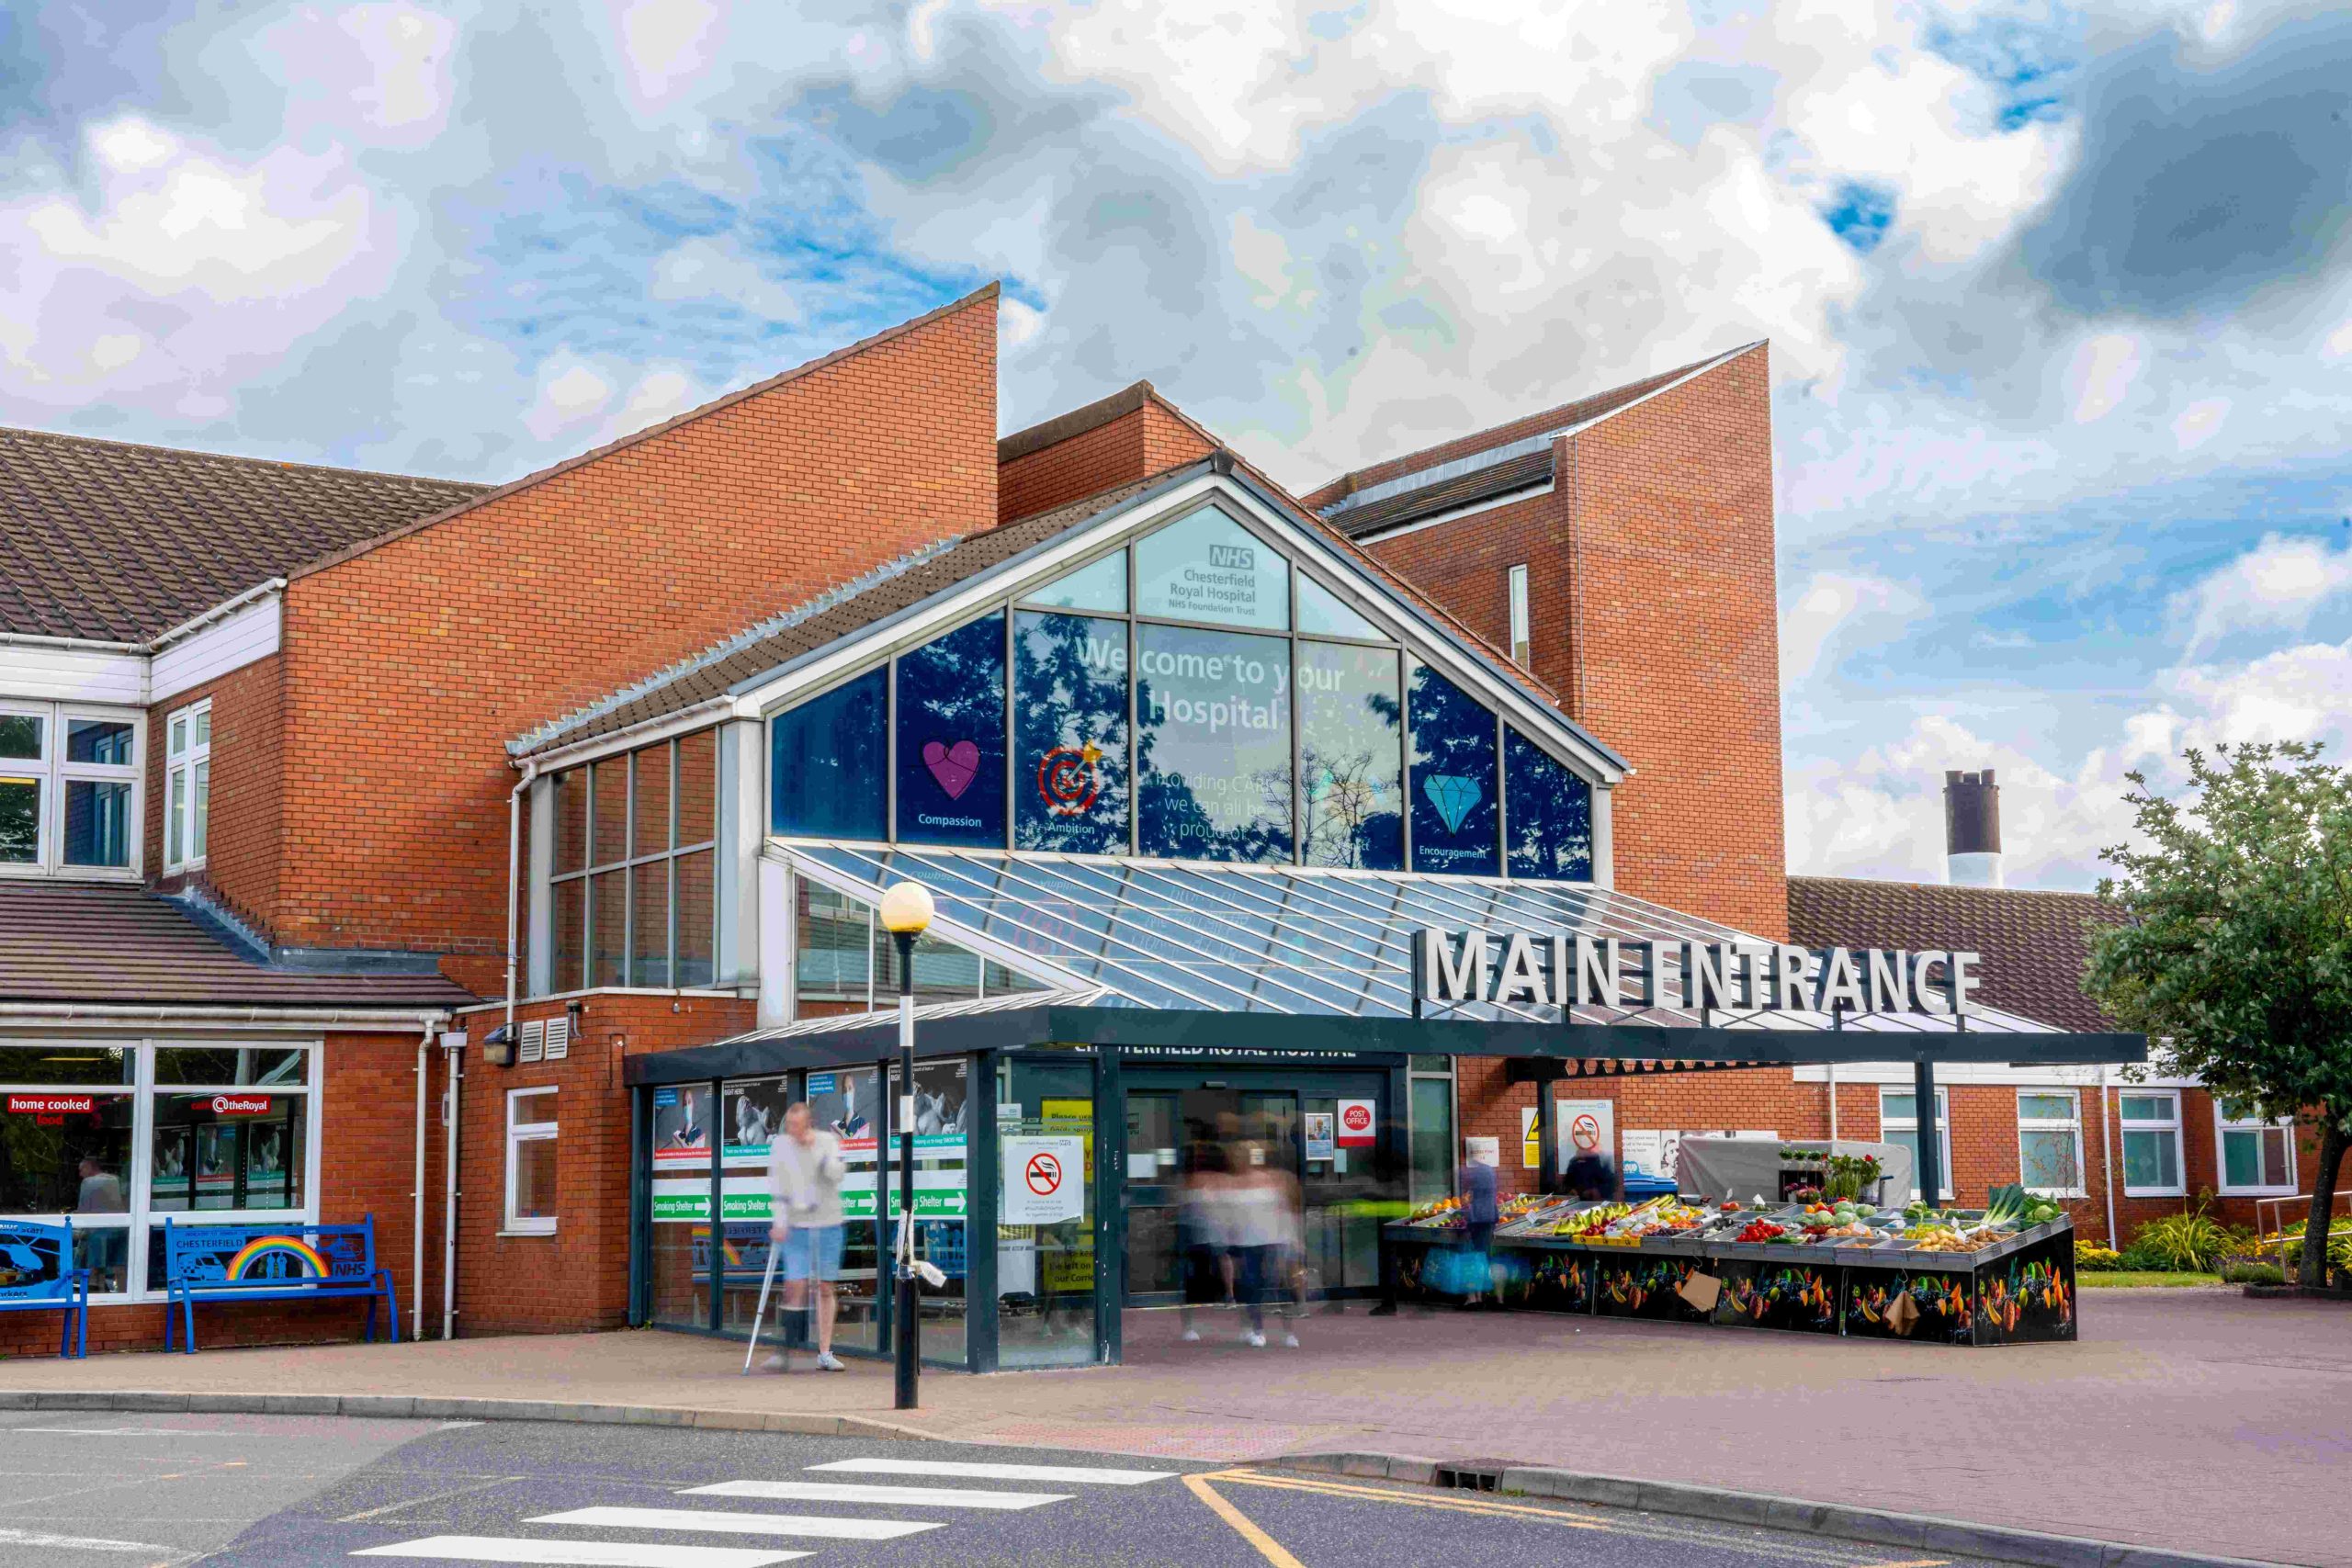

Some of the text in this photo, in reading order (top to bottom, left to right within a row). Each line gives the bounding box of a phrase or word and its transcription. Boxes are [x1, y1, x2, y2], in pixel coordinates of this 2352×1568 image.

[1210, 545, 1254, 570] NHS
[1184, 569, 1255, 588] Chesterfield
[1170, 583, 1255, 604] Royal Hospital
[1169, 599, 1256, 616] NHS Foundation Trust
[1075, 637, 1345, 695] Welcome to your
[1149, 690, 1278, 733] Hospital
[1164, 797, 1265, 817] we can all be
[918, 813, 982, 828] Compassion
[1048, 821, 1095, 835] Ambition
[1180, 822, 1247, 840] proud of
[1419, 845, 1487, 860] Encouragement
[1419, 928, 1983, 1016] MAIN ENTRANCE
[11, 1098, 90, 1111] home cooked
[654, 1201, 693, 1213] Smoking Shelter
[723, 1200, 766, 1213] Smoking Shelter
[920, 1195, 942, 1207] Shelter
[175, 1238, 243, 1248] CHESTERFIELD
[334, 1263, 366, 1277] NHS
